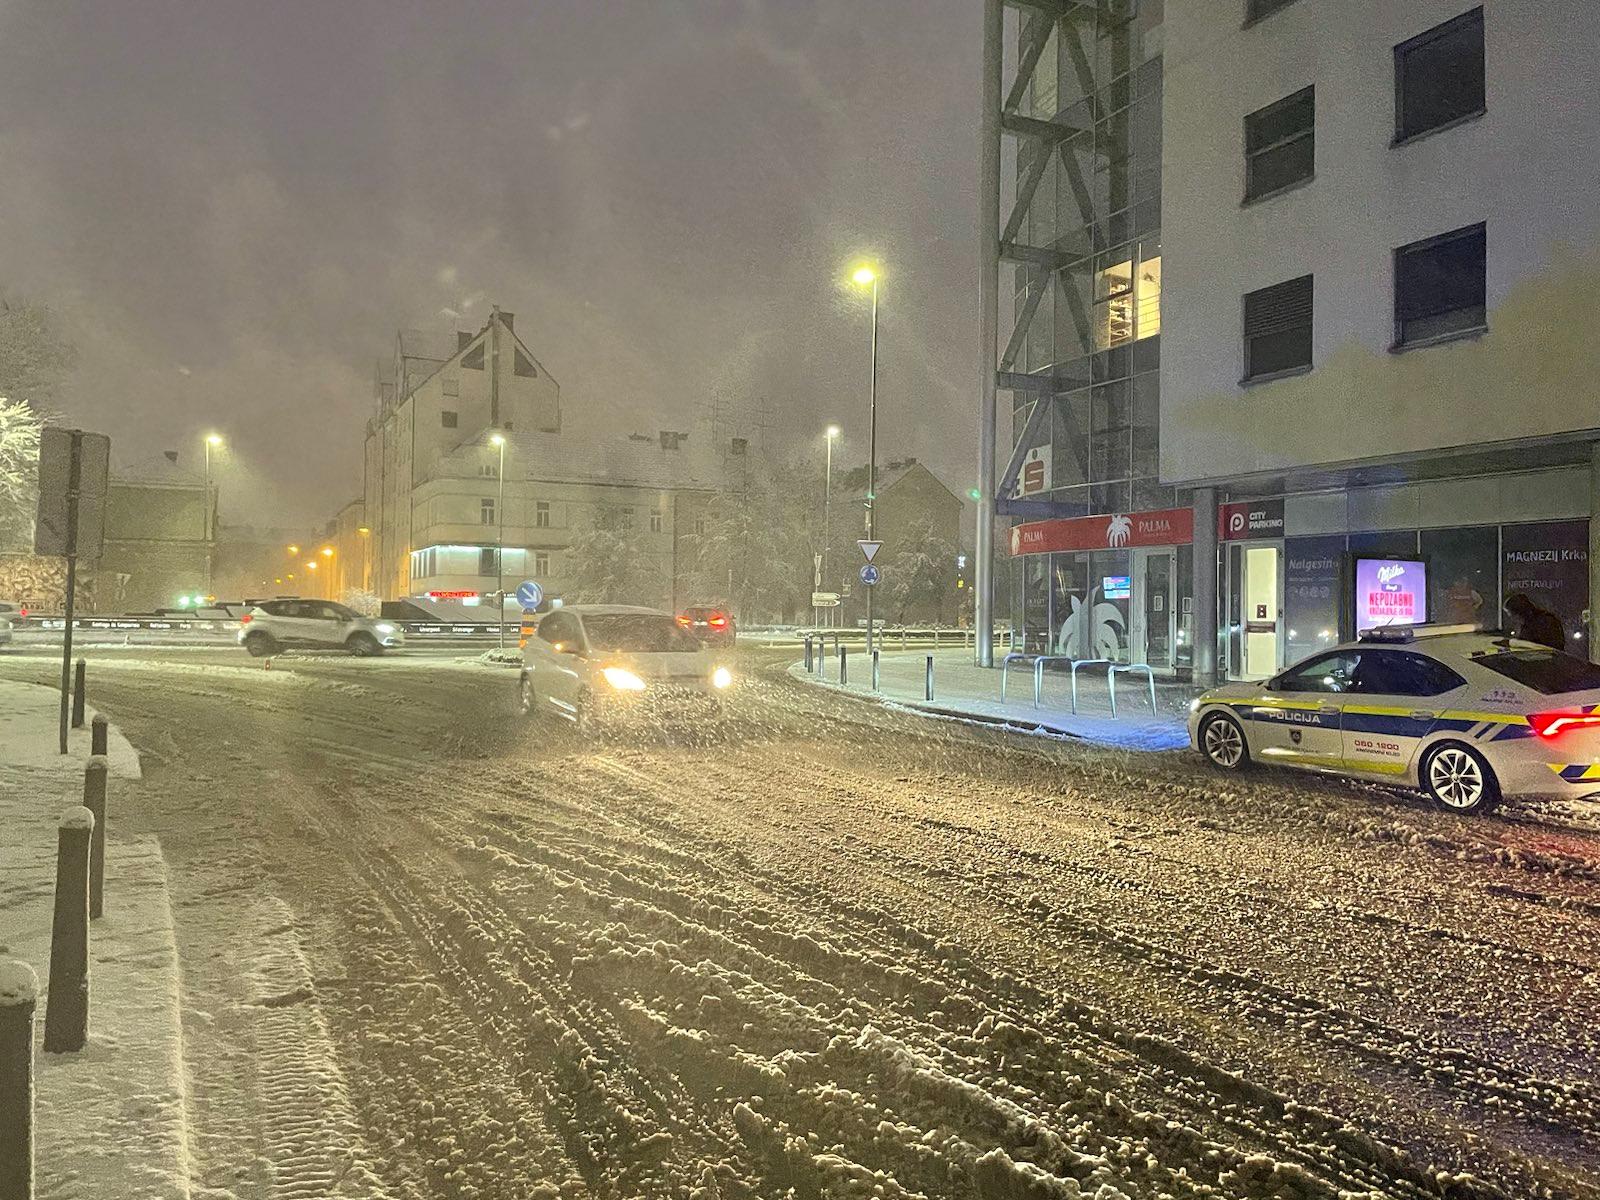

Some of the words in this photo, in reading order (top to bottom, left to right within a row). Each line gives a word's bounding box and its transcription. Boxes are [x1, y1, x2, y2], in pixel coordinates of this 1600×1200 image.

[1249, 511, 1267, 521] CITY
[1138, 519, 1171, 533] PALMA
[1249, 518, 1283, 530] PARKING
[1023, 531, 1044, 543] PALMA
[1506, 550, 1558, 562] MAGNEZIJ
[1561, 548, 1587, 561] Krka
[1377, 564, 1406, 583] Milka
[1369, 592, 1413, 607] NEPOZABNO
[1269, 710, 1321, 724] POLICIJA
